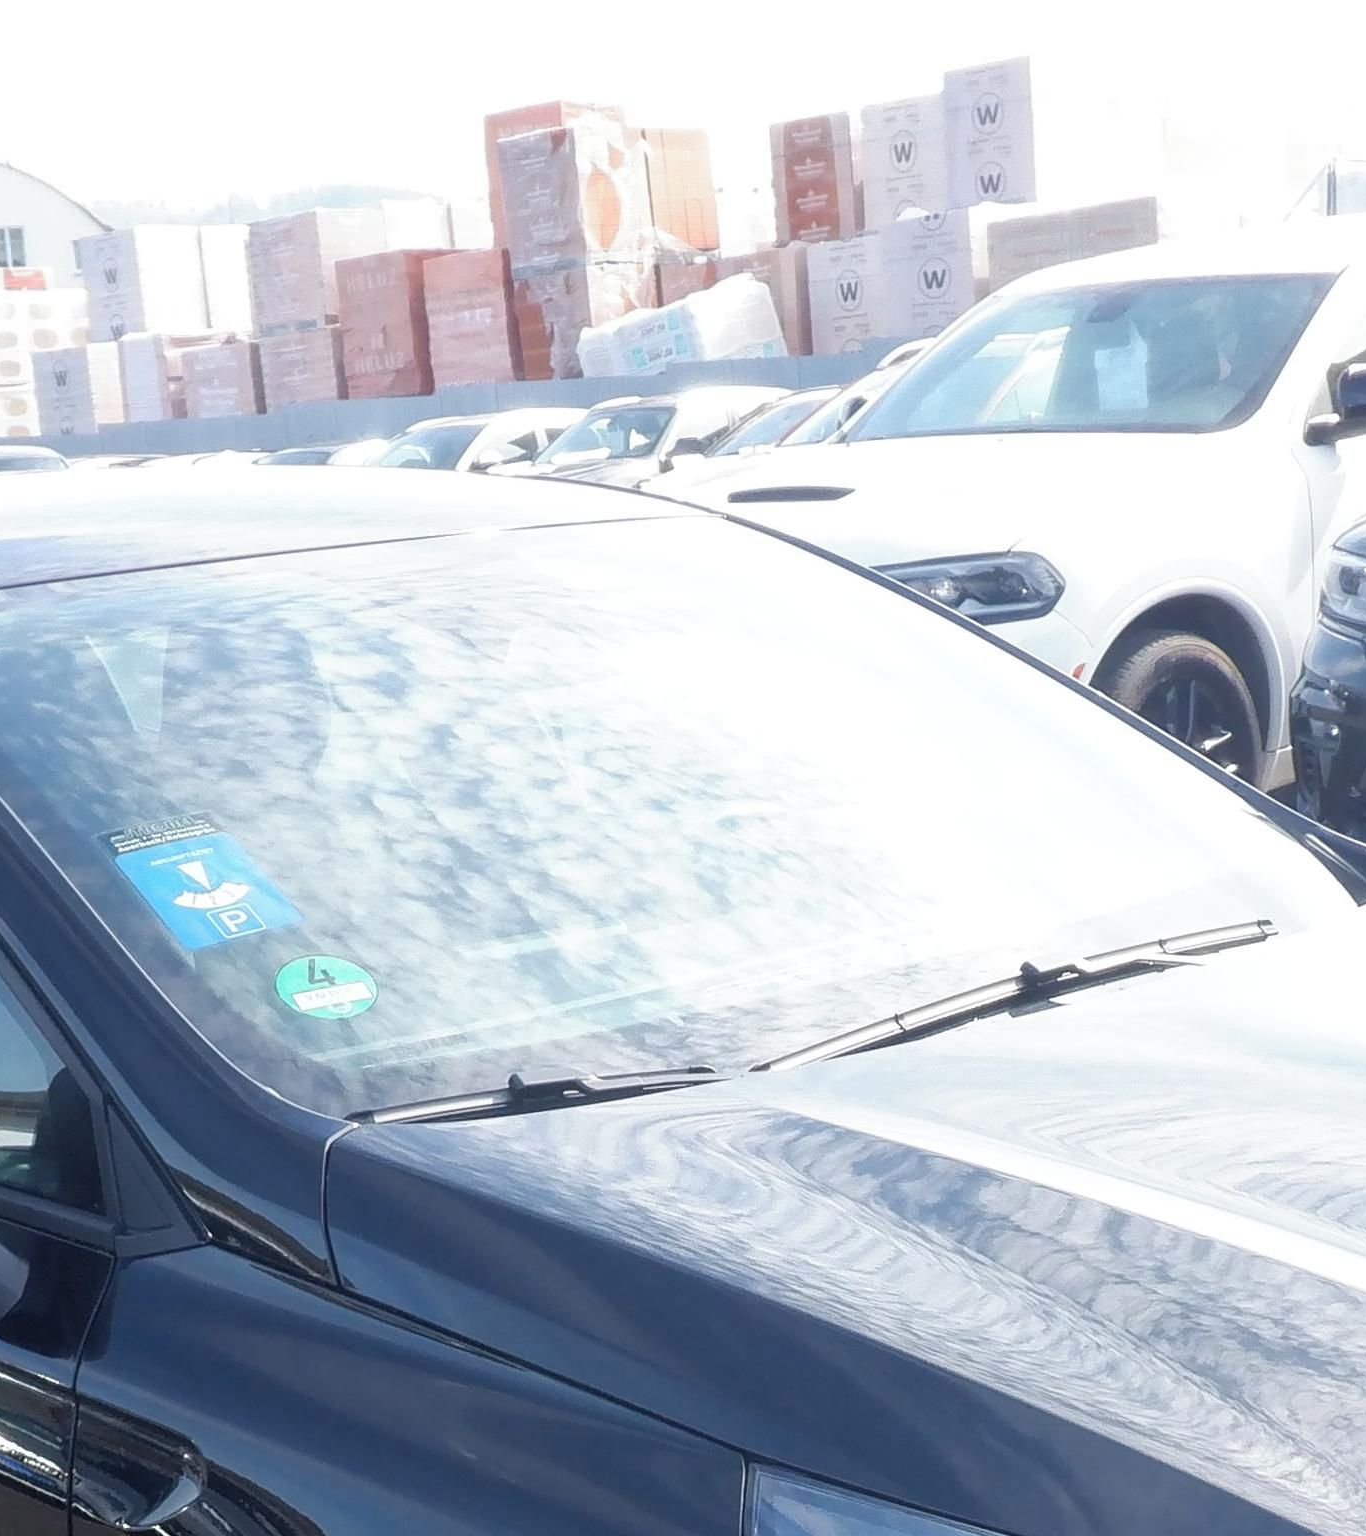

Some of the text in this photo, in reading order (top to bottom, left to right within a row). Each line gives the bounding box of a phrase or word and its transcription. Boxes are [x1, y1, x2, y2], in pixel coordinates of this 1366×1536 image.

[976, 102, 999, 126] W
[894, 141, 913, 163] W
[980, 173, 1001, 194] W
[103, 267, 118, 284] W
[923, 269, 947, 290] W
[839, 281, 859, 302] W
[355, 351, 404, 375] HELUZ
[52, 370, 69, 387] W
[218, 909, 248, 933] P
[308, 958, 336, 985] 4
